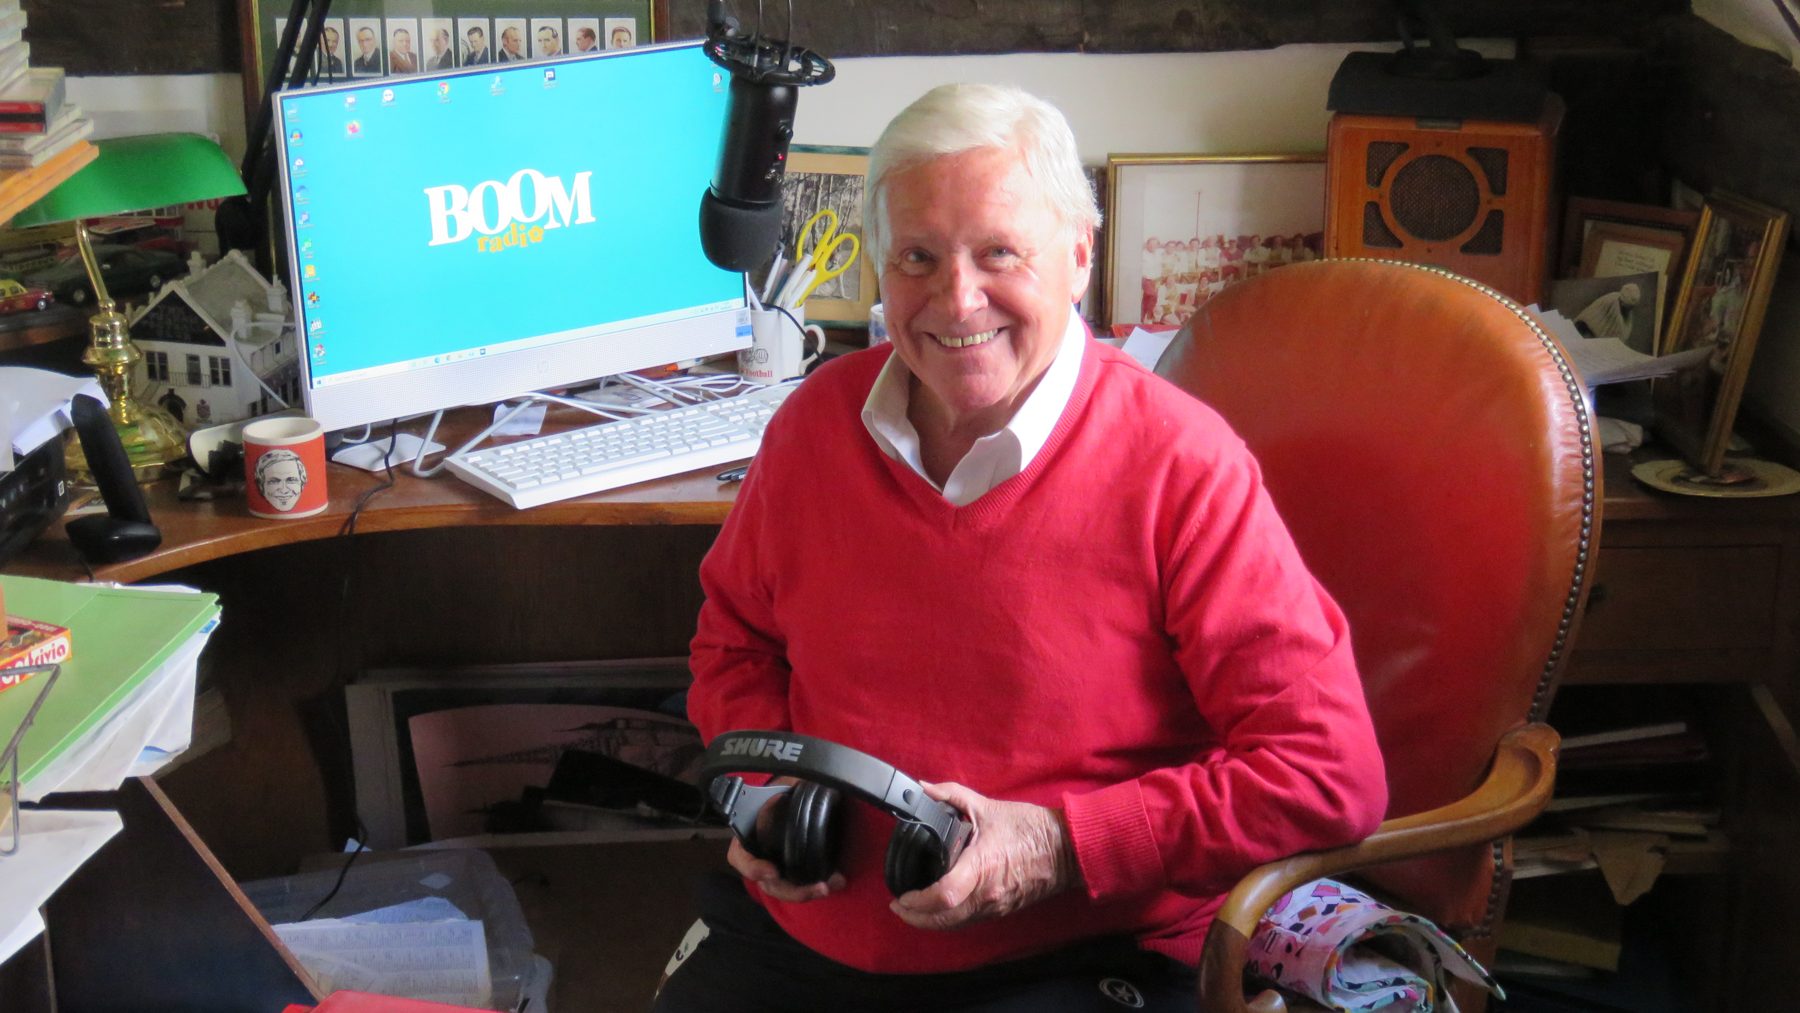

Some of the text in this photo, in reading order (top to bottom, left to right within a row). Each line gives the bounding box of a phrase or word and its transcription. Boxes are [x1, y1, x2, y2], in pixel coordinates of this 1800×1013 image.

[424, 168, 596, 246] BOOM
[477, 222, 544, 252] radio
[720, 738, 804, 762] SHURE
